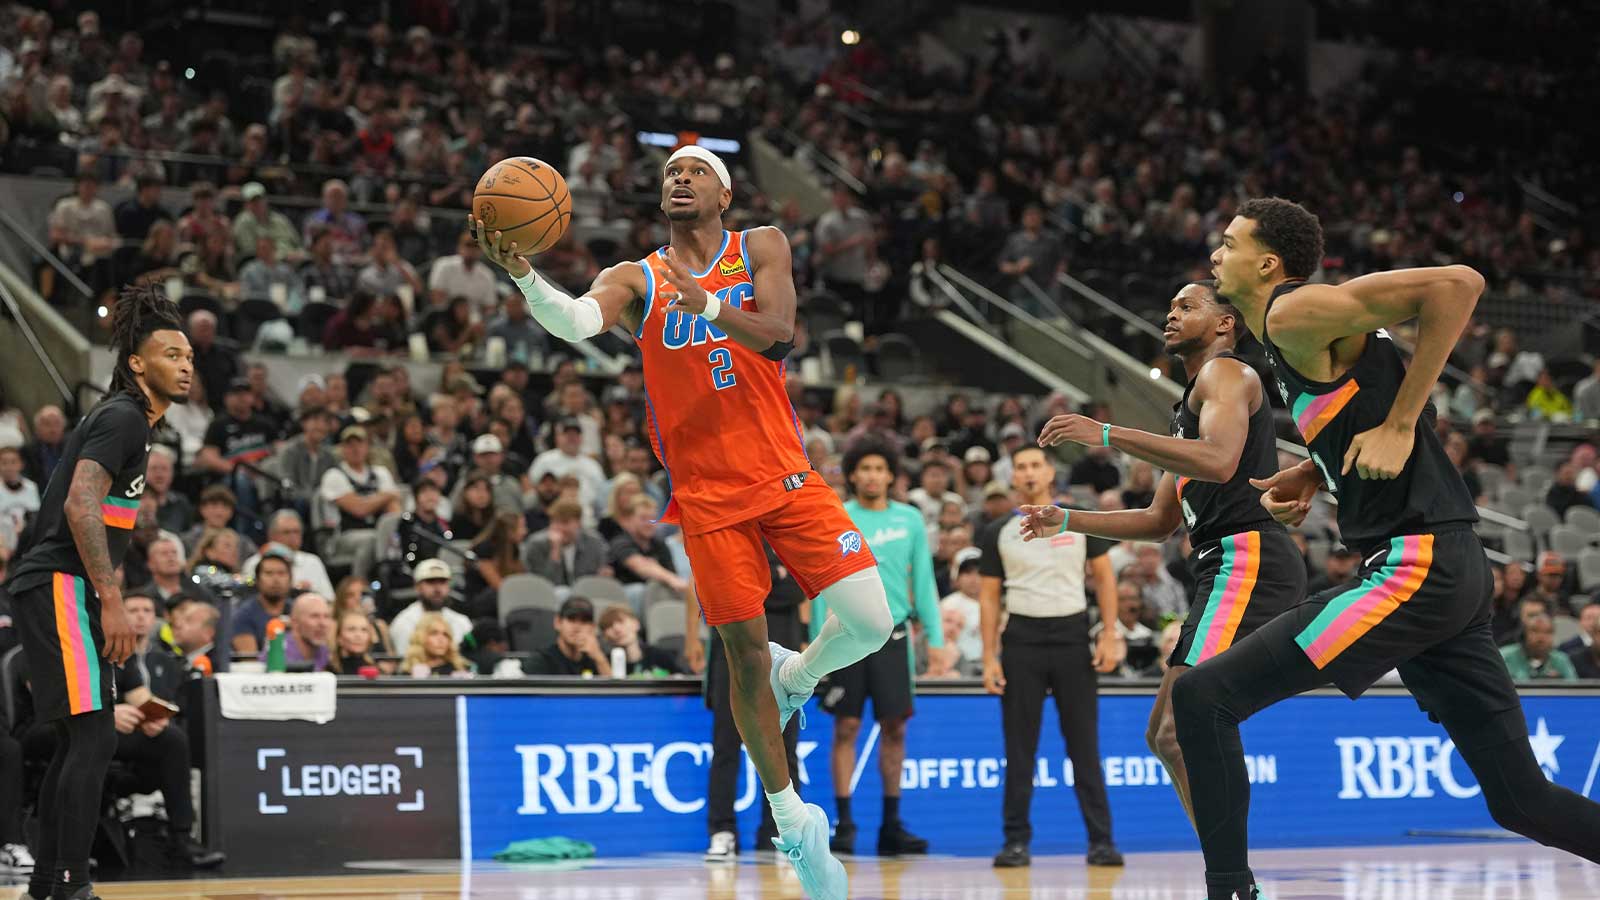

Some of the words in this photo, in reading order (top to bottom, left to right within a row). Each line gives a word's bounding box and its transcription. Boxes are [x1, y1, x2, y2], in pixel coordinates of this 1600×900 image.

[709, 347, 737, 391] 2
[282, 764, 401, 797] LEDGER
[899, 757, 1058, 790] OFFICL
[1062, 756, 1172, 787] CEDI
